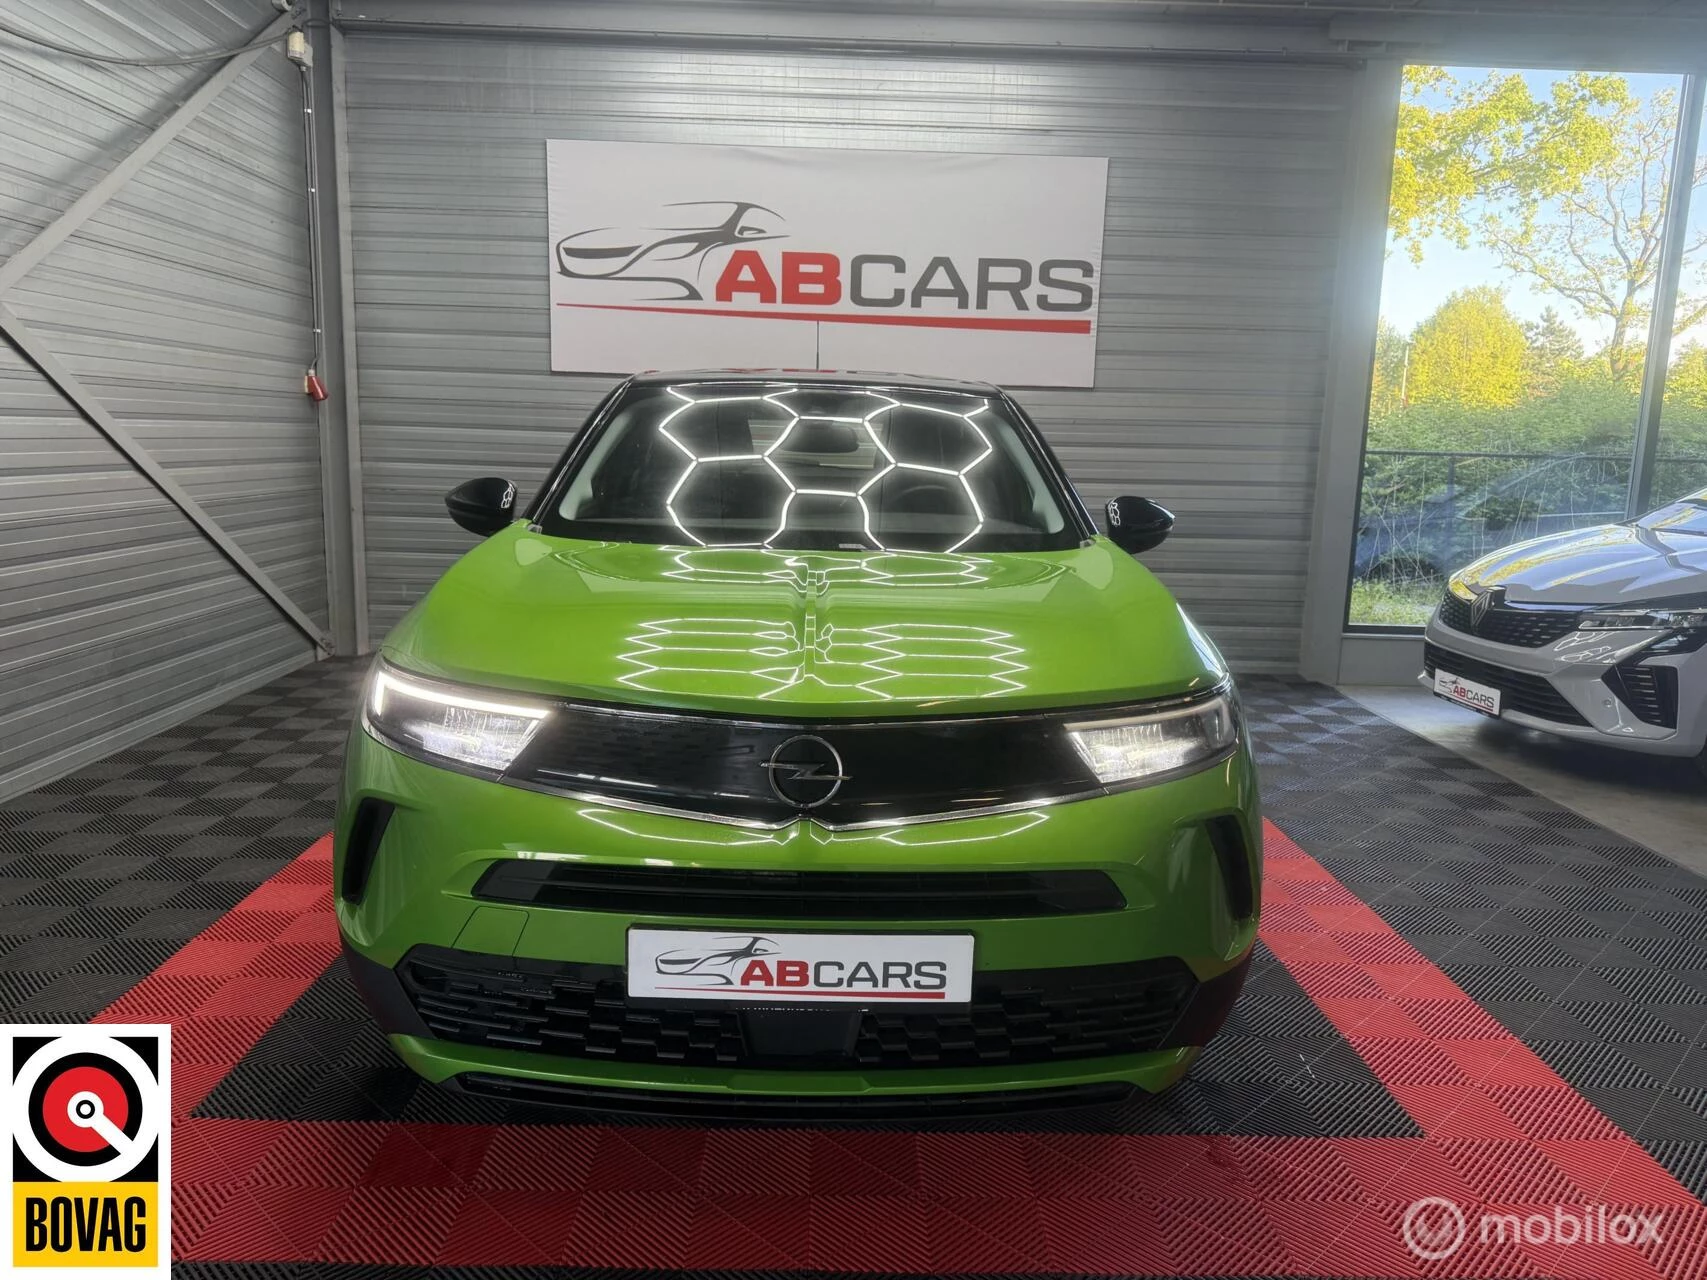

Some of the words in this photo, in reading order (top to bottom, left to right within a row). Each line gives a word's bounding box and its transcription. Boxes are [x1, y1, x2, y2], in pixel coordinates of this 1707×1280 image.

[715, 249, 1095, 312] ABCARS
[1453, 685, 1494, 708] ABCARS
[740, 959, 947, 990] ABCARS
